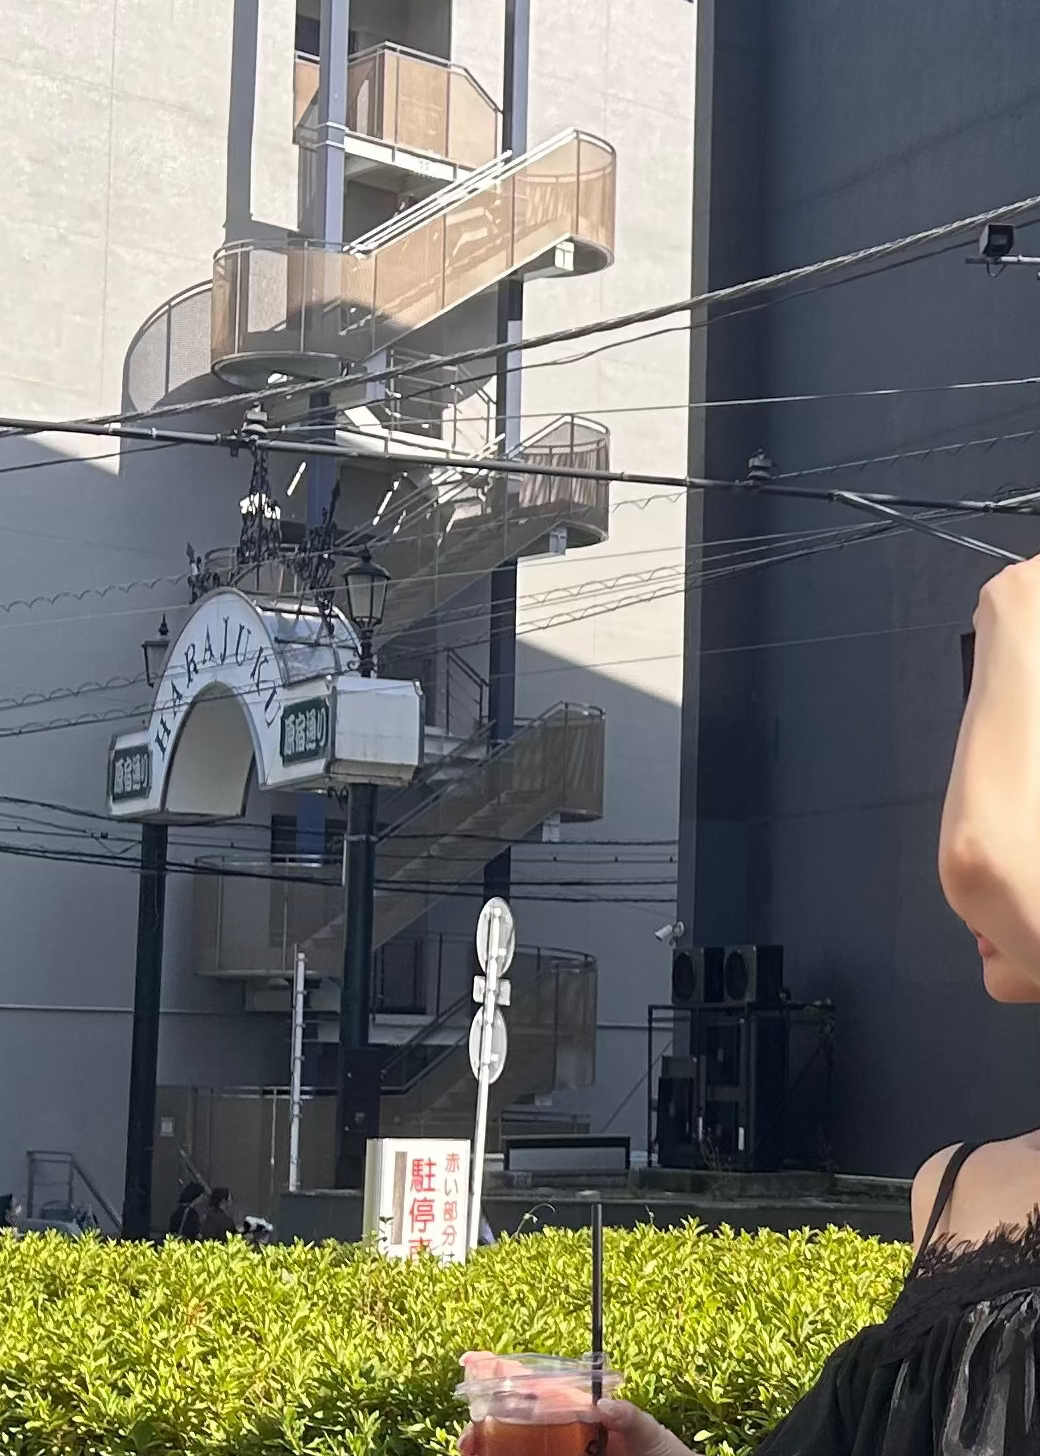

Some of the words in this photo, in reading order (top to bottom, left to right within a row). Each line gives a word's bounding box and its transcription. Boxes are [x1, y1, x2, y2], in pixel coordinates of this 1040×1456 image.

[154, 615, 281, 761] HARAJUKU
[284, 707, 326, 756] 原宿通り
